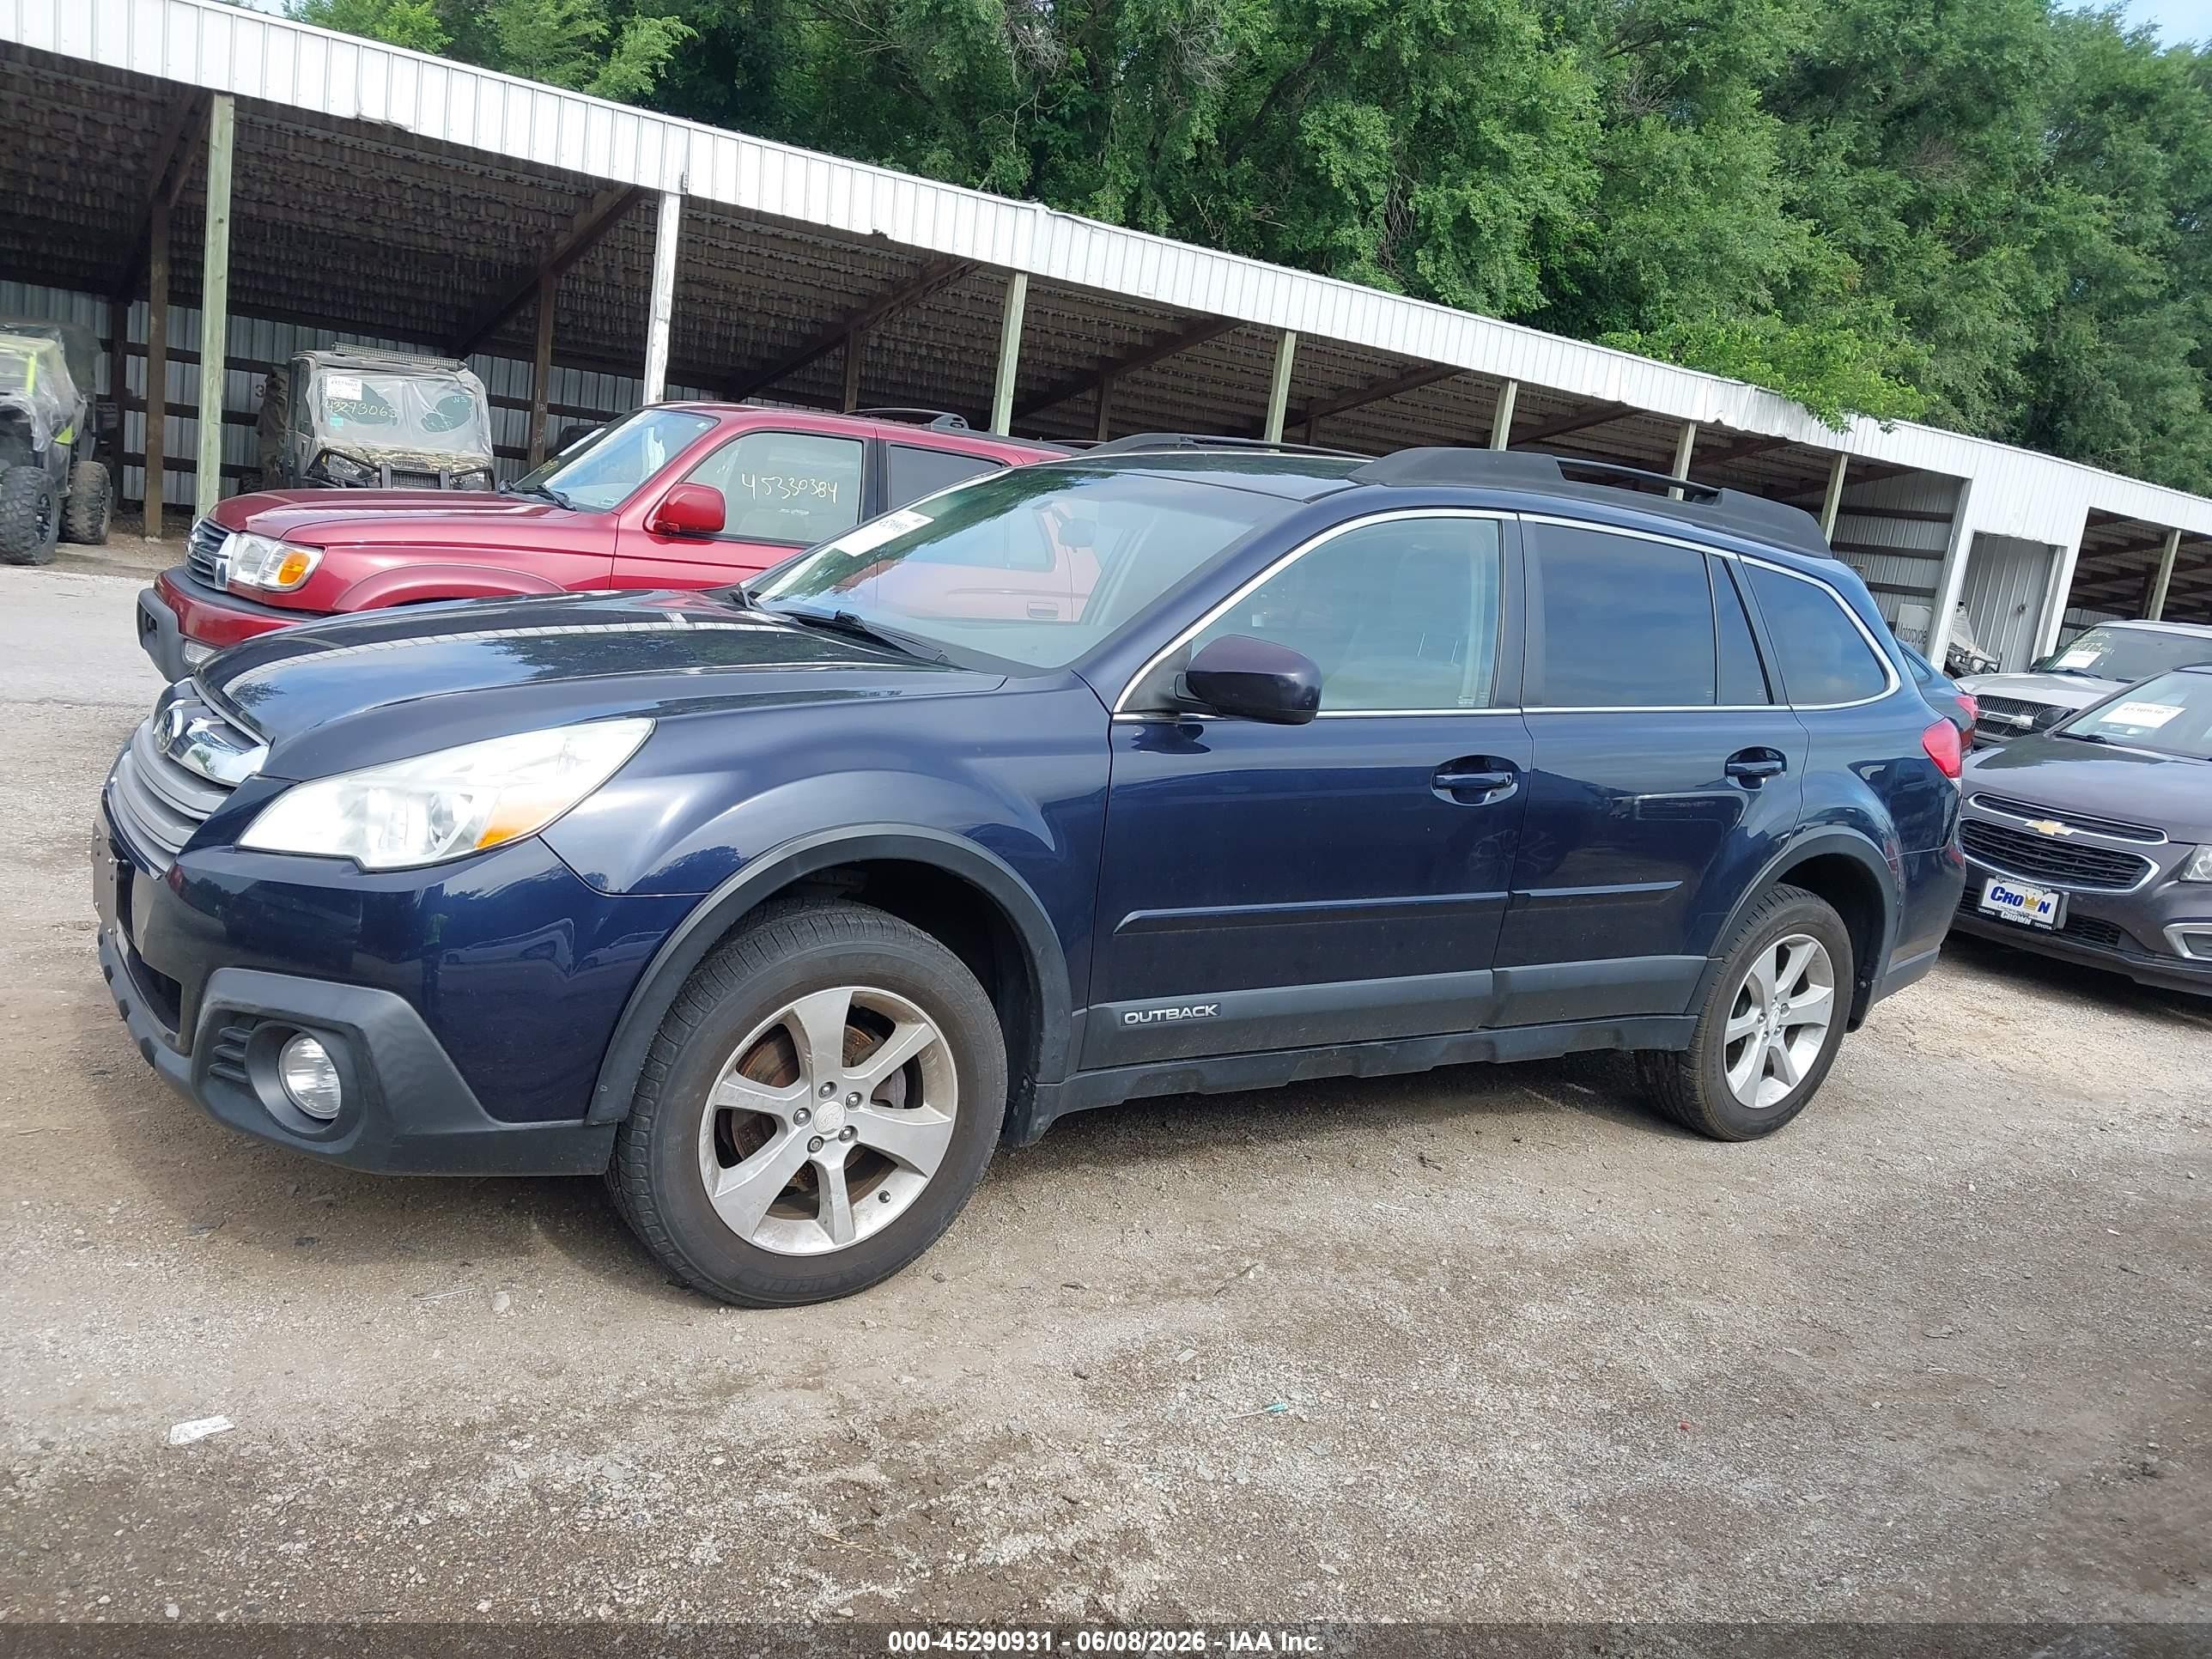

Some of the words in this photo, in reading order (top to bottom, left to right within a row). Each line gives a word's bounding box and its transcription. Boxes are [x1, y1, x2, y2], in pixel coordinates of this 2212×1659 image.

[741, 473, 837, 504] 45330384
[1896, 621, 1927, 648] Motorcycle
[1124, 1004, 1218, 1024] OUTBACK
